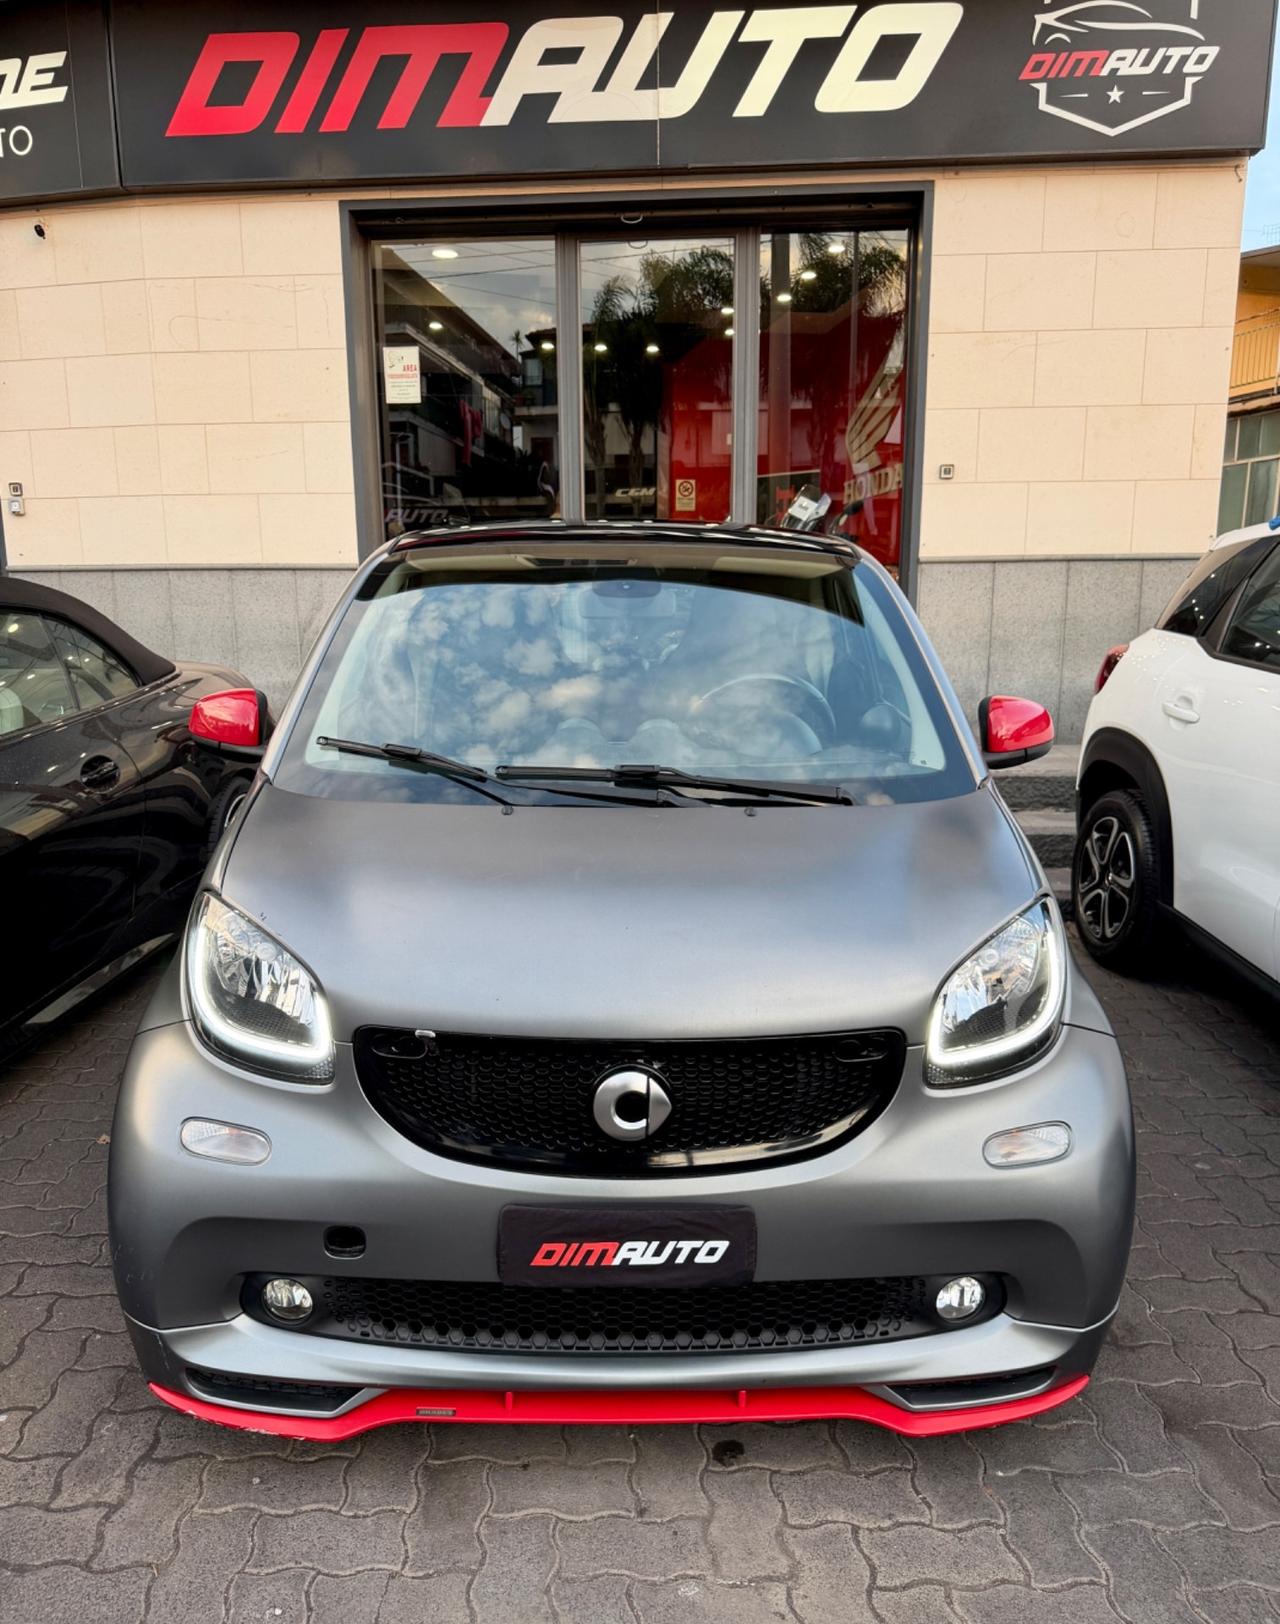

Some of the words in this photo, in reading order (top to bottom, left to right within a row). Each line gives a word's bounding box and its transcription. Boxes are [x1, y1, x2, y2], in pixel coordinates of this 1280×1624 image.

[165, 3, 963, 136] DIMAUTO
[1018, 46, 1220, 80] DIMAUTO
[843, 463, 903, 504] HONDA
[529, 1240, 730, 1267] DIMAUTO
